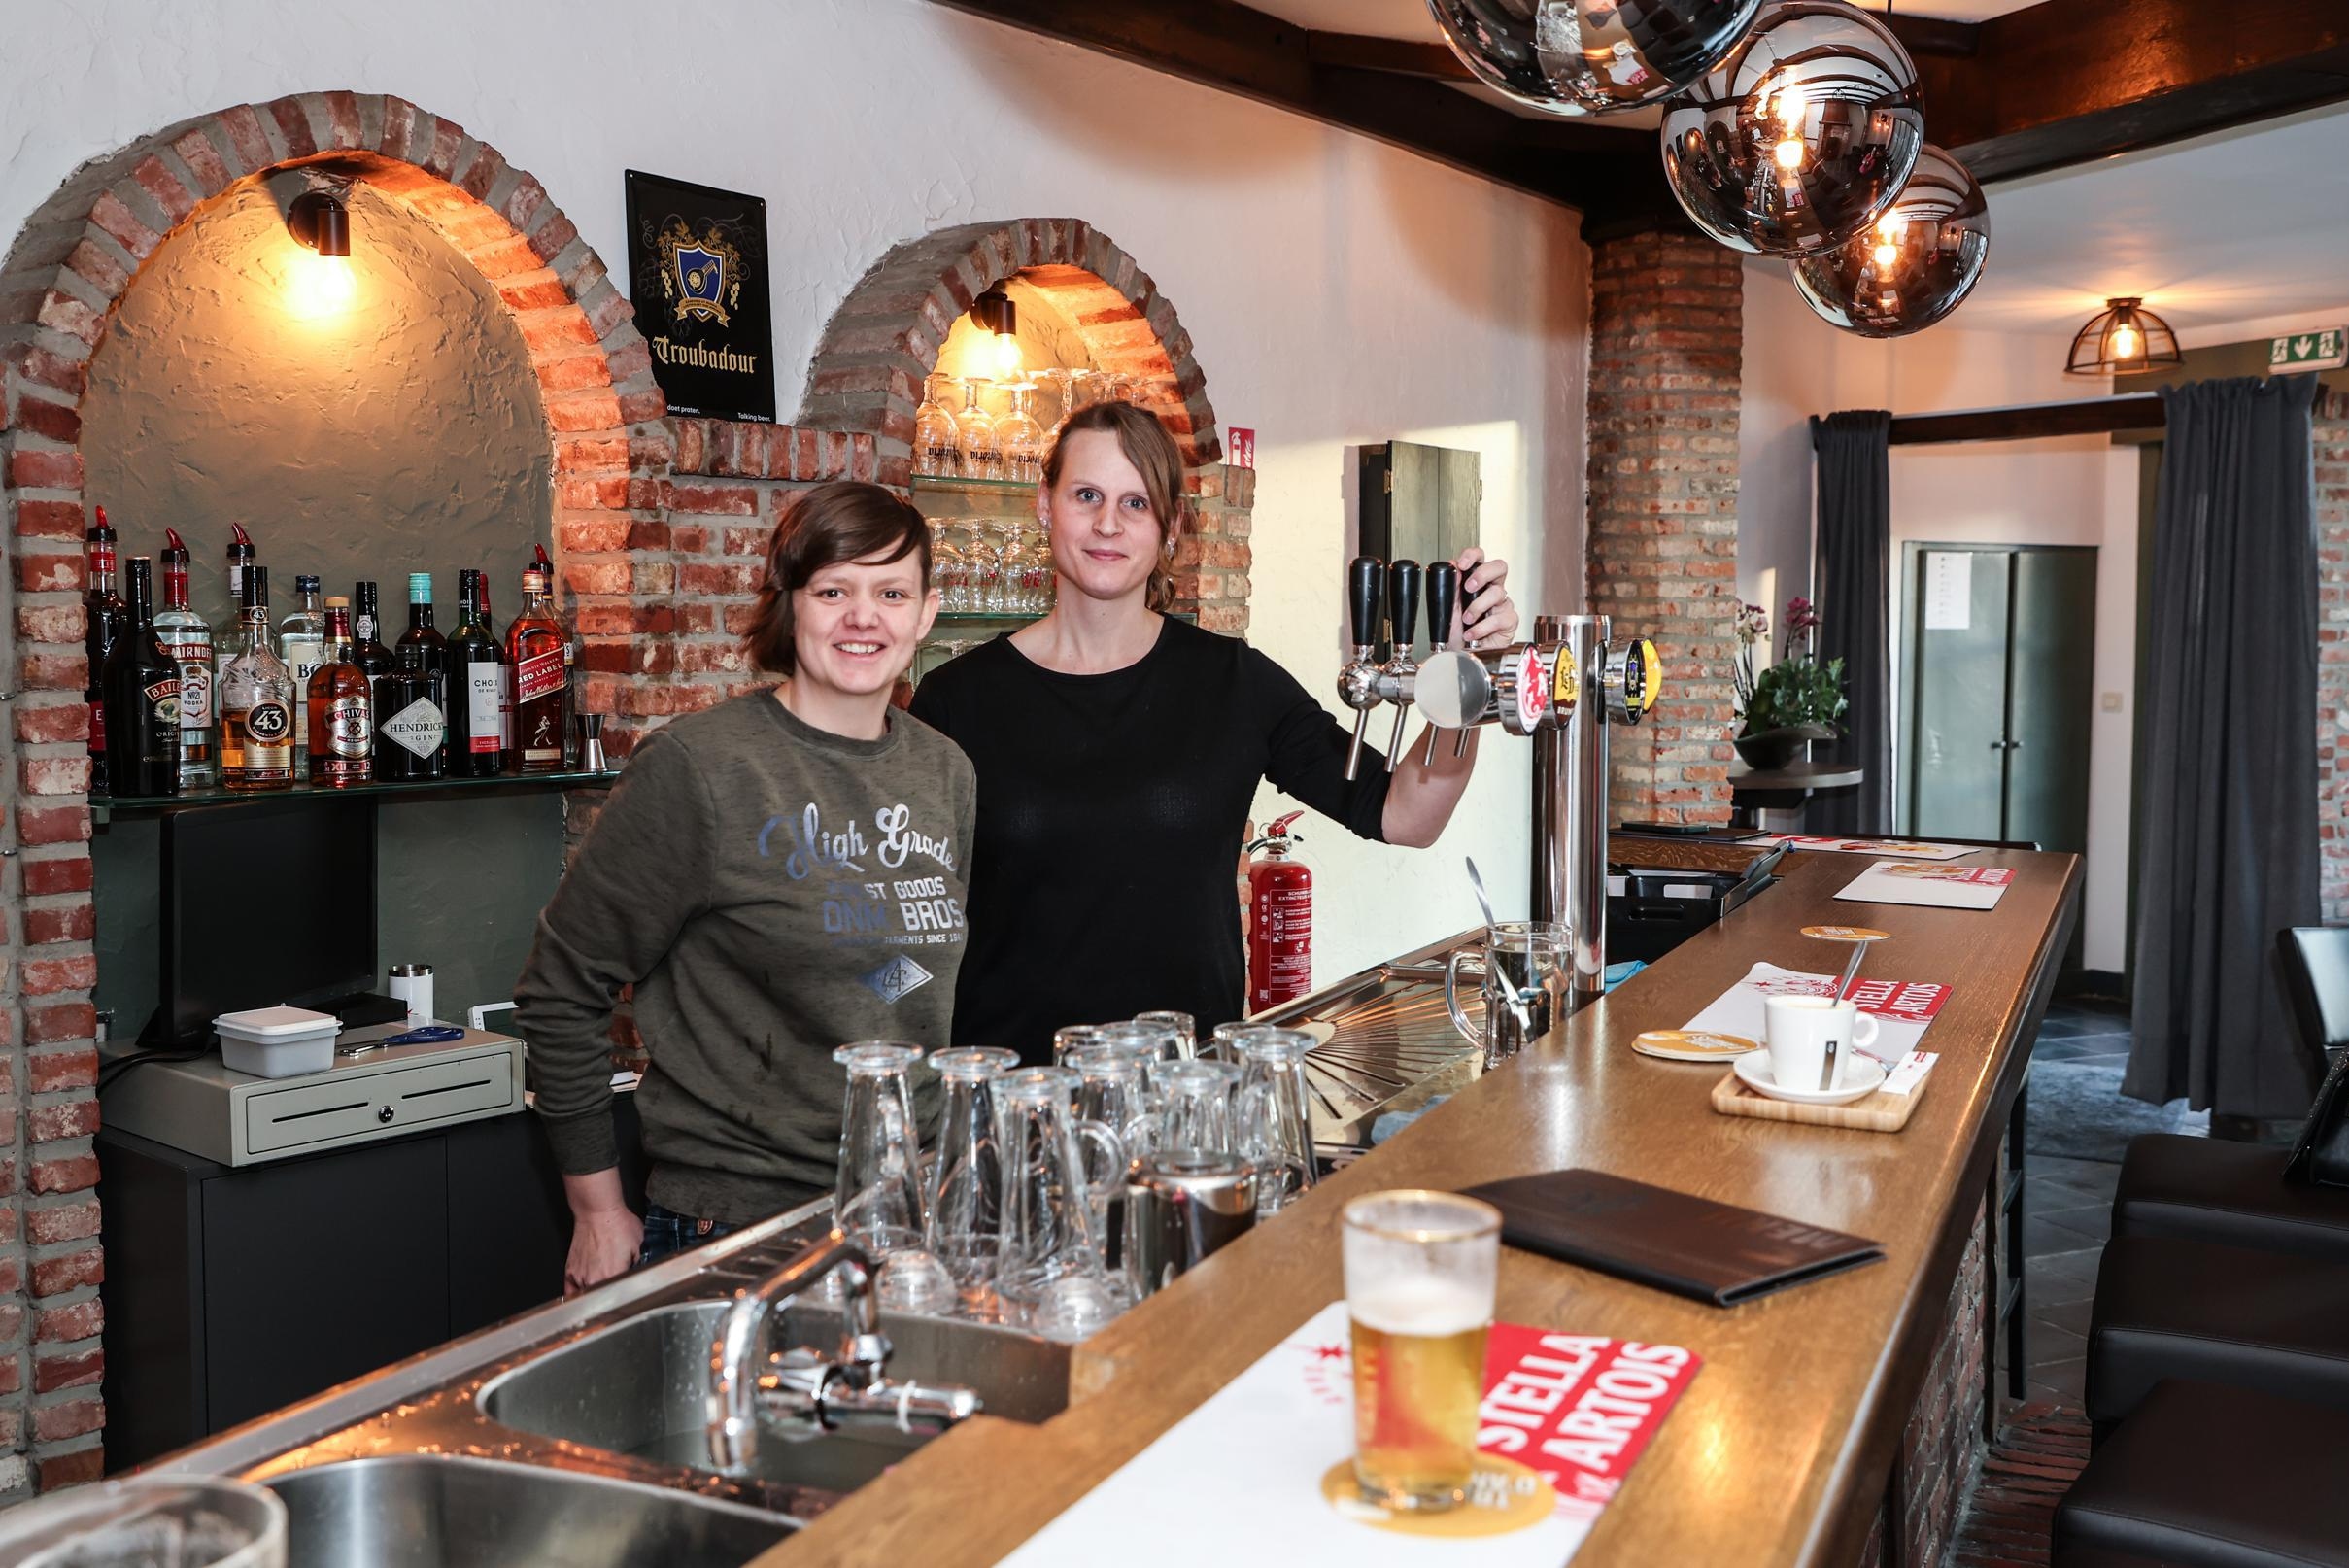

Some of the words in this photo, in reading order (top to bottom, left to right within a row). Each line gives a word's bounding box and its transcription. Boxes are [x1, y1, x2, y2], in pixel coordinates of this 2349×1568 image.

[652, 336, 758, 374] Troubadour
[738, 413, 757, 422] Talking
[254, 610, 264, 619] 43
[171, 645, 212, 659] MIRNOFF
[518, 673, 535, 683] RED
[536, 663, 562, 677] LABEL
[151, 680, 180, 698] BAILE
[254, 710, 282, 730] 43
[334, 708, 370, 720] CHIVAS
[875, 803, 957, 872] Grade
[893, 876, 947, 899] GOODS
[899, 898, 964, 931] BROS
[926, 933, 947, 944] SINCE
[1889, 982, 1942, 1014] ARTOIS
[1476, 1335, 1612, 1453] STELLA
[1541, 1342, 1690, 1472] ARTOIS
